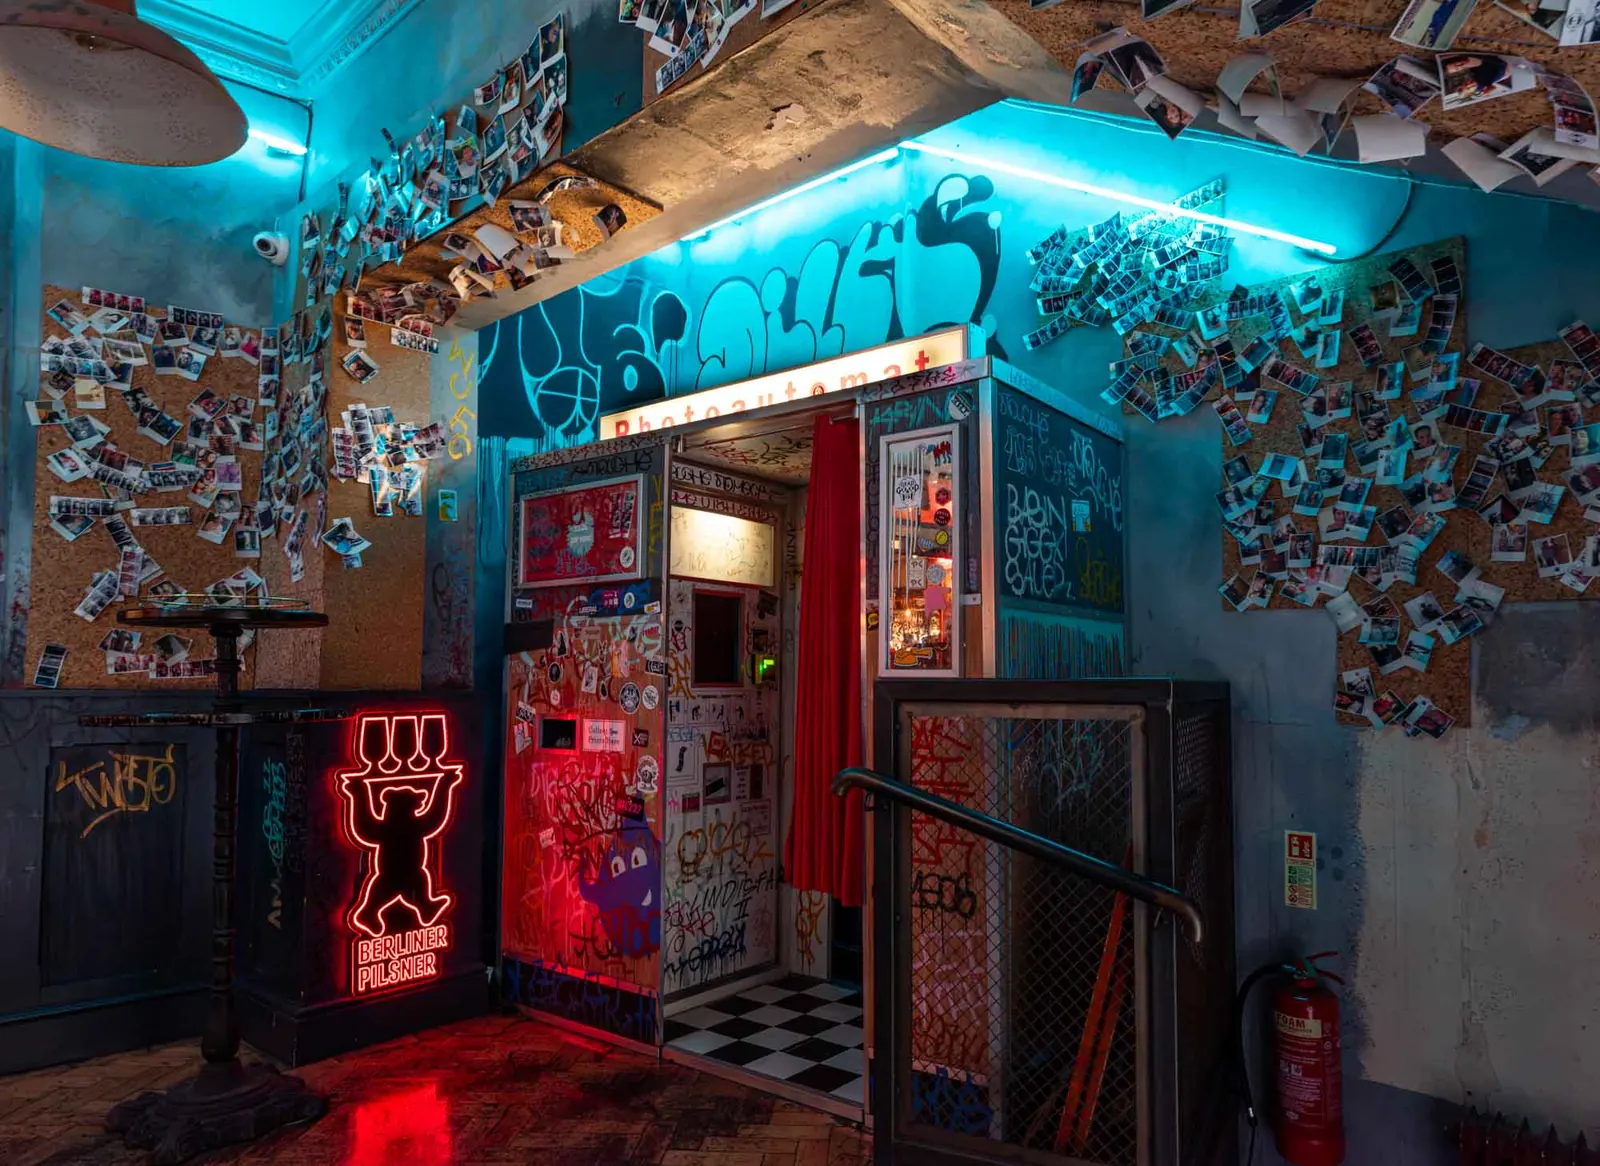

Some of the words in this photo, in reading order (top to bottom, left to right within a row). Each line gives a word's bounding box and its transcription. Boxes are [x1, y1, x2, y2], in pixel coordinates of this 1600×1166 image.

[615, 350, 930, 437] Photoautomat
[358, 924, 448, 965] BERLINER
[358, 952, 436, 992] PILSNER
[1276, 1013, 1305, 1030] FOAM
